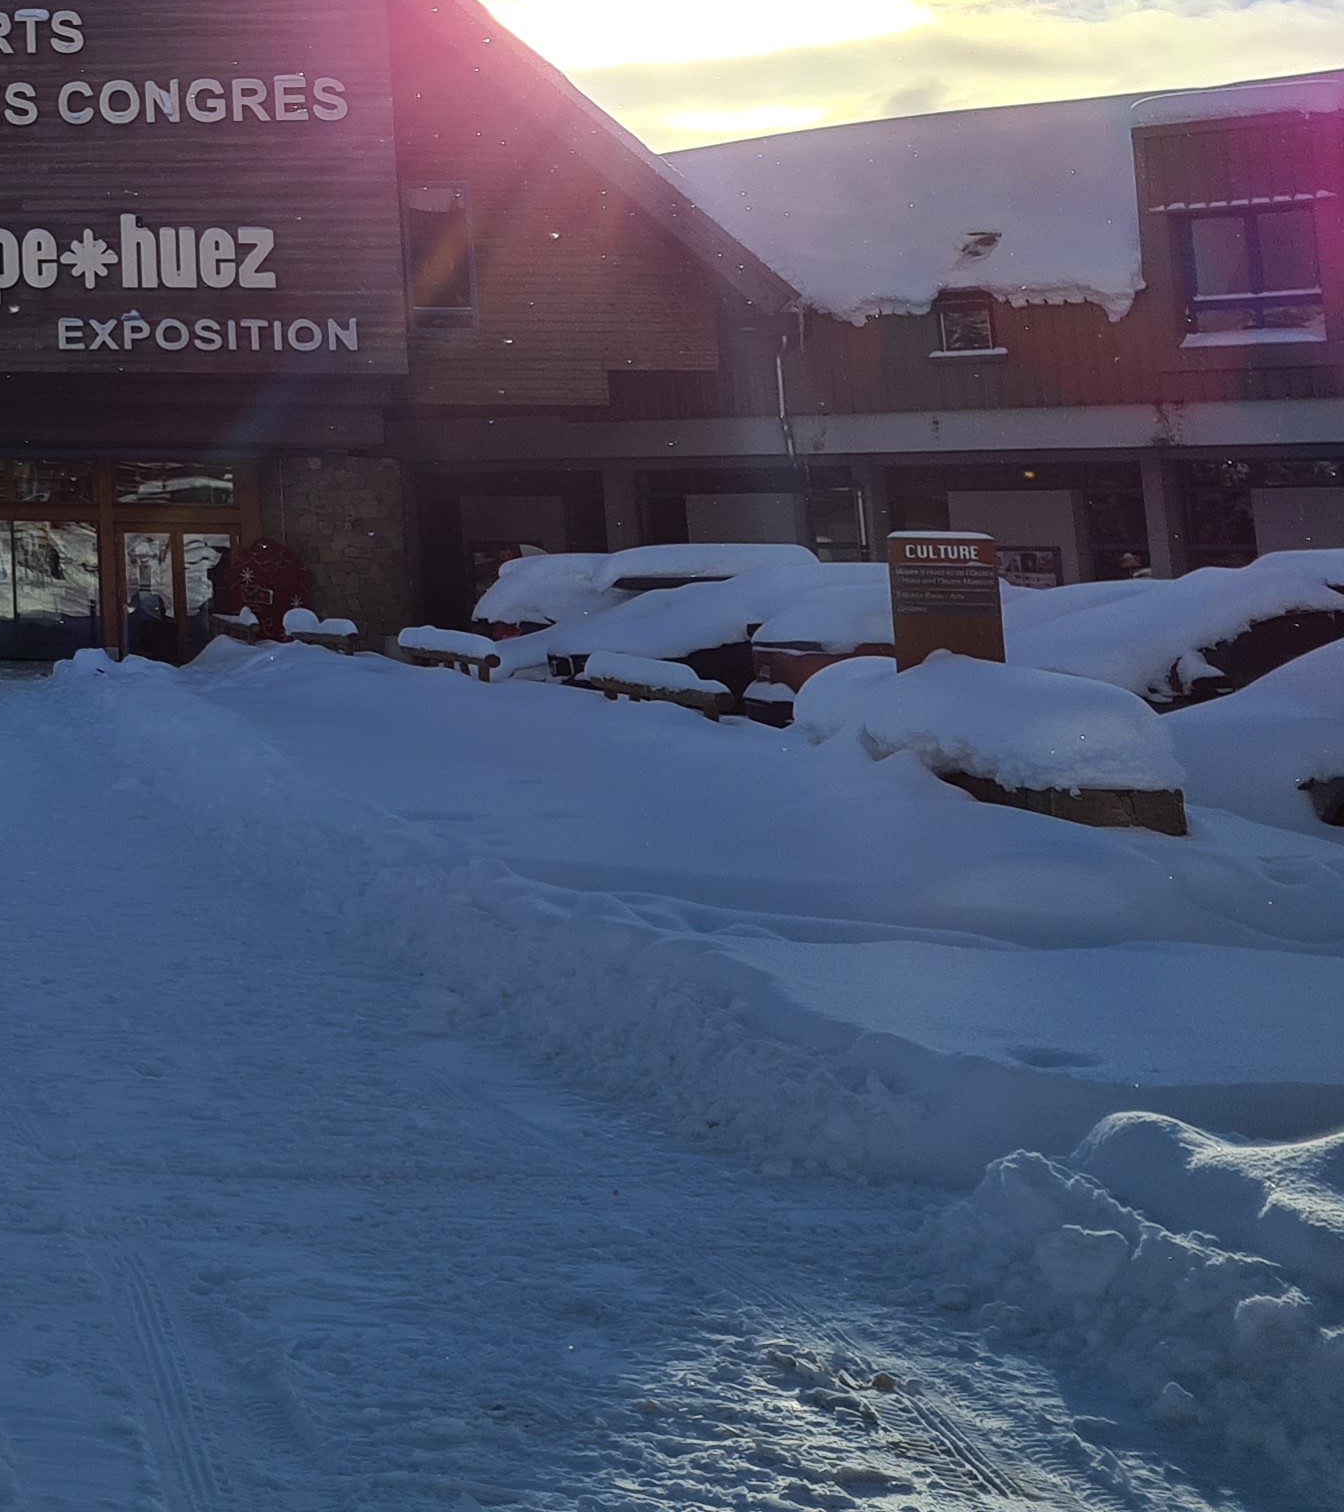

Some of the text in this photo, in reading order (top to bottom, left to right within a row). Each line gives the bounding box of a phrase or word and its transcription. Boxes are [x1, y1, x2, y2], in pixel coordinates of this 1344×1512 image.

[57, 75, 349, 124] CONGRES
[57, 317, 359, 352] EXPOSITION
[904, 544, 980, 560] CULTURE
